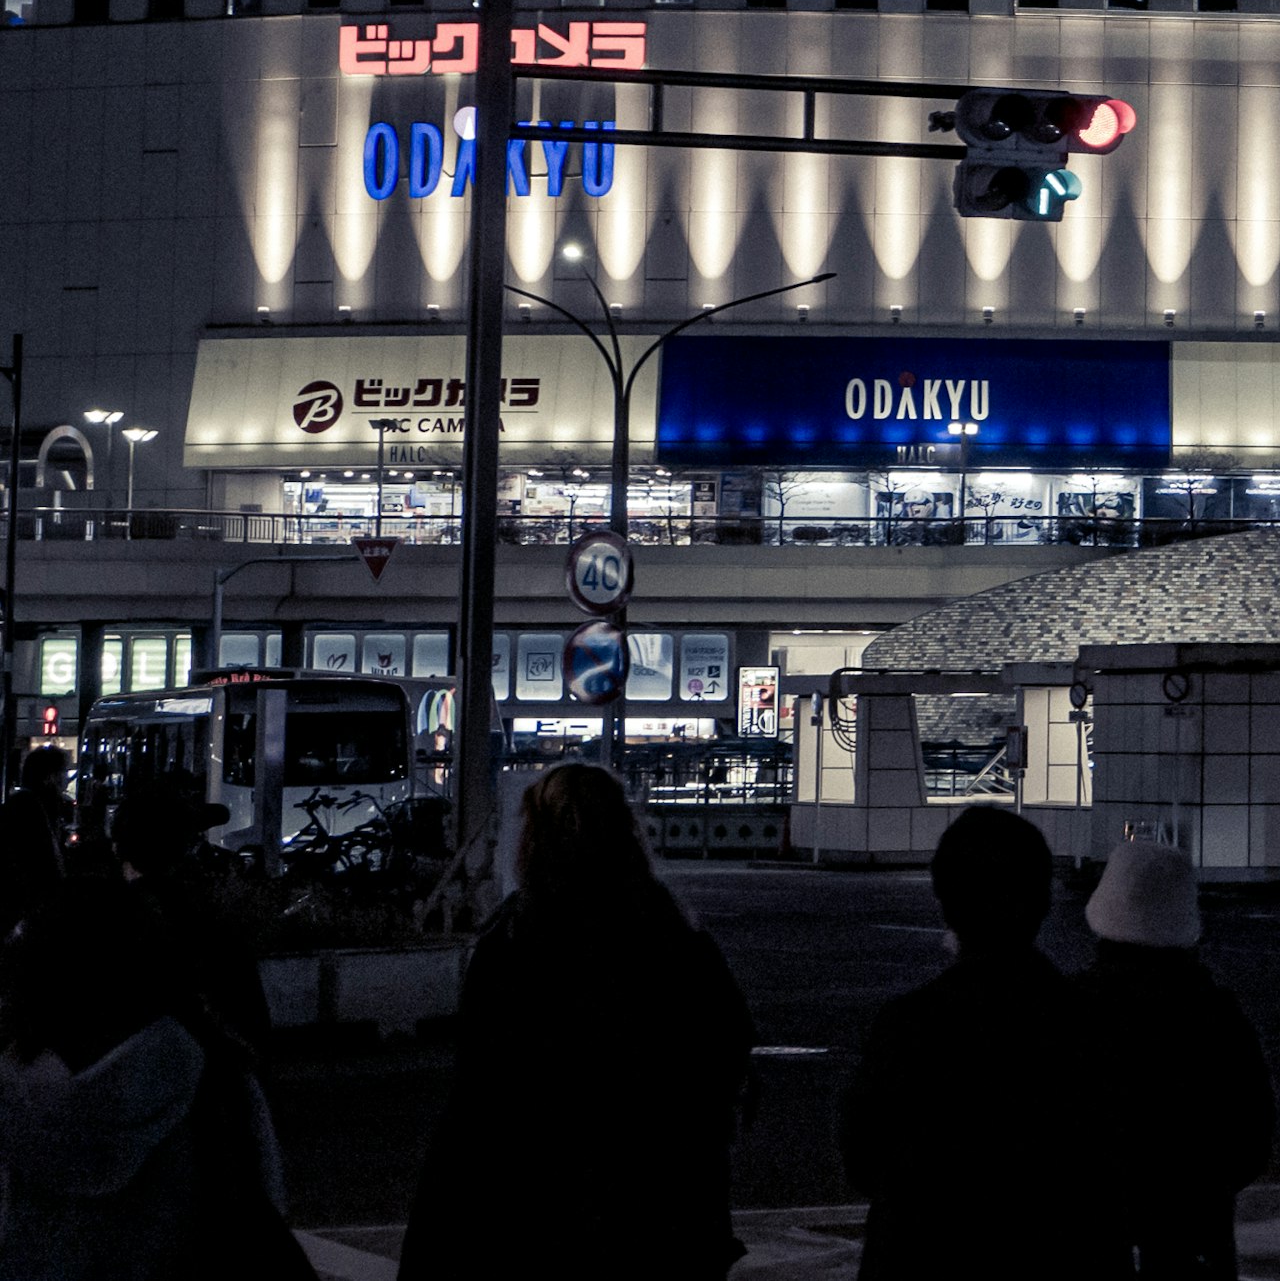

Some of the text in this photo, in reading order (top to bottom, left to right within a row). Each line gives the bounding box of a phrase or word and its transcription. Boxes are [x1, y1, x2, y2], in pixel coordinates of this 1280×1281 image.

[846, 375, 991, 422] ODAKYU
[390, 446, 425, 463] HALC
[896, 445, 936, 465] HALC
[581, 552, 621, 591] 40
